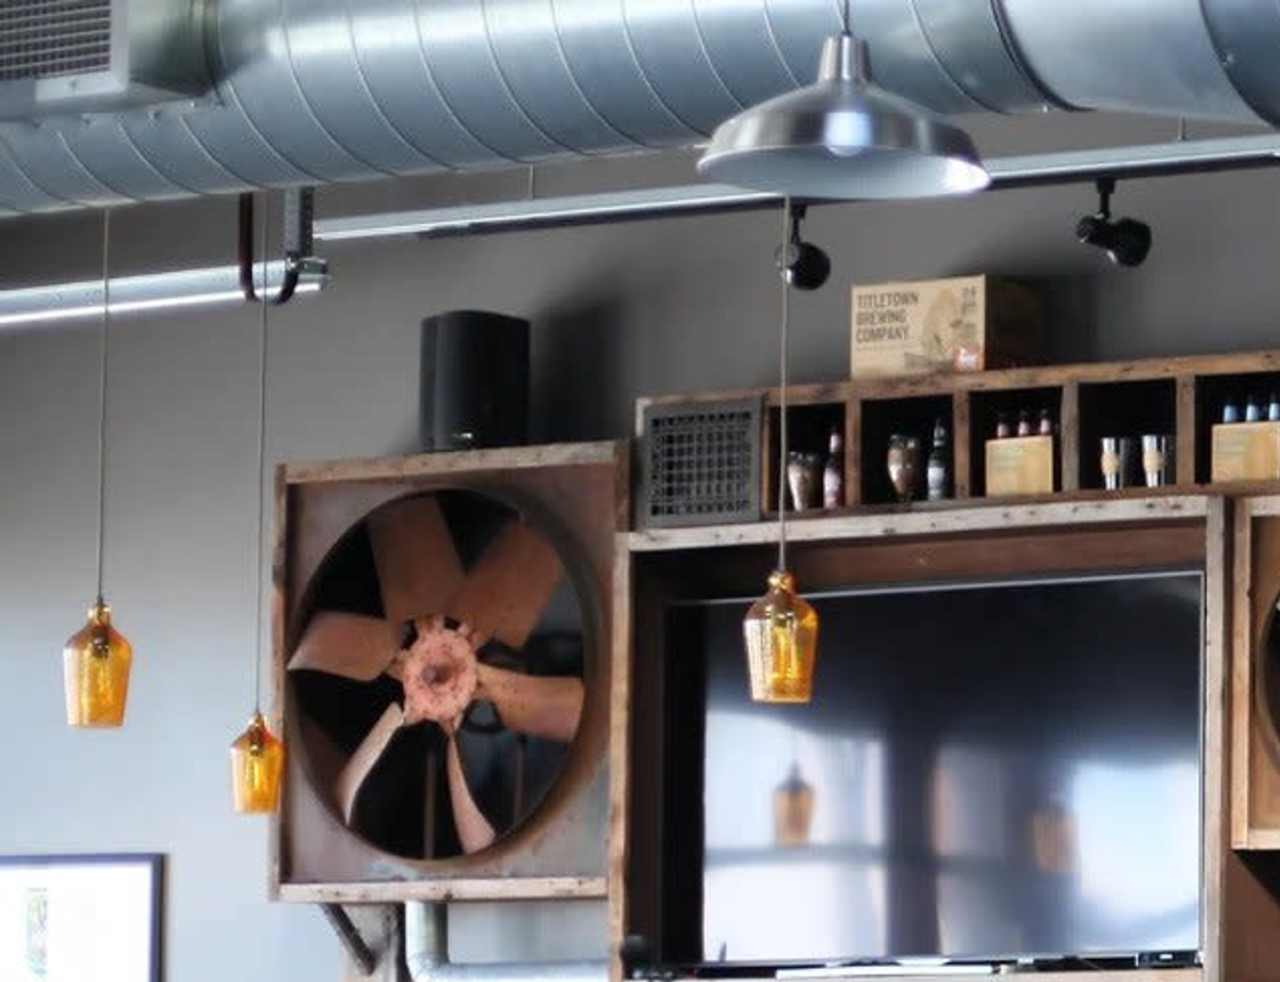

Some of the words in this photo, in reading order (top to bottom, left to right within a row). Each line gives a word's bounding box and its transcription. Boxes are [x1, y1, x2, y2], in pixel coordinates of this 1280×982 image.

[856, 291, 919, 308] TITLETOWN
[856, 308, 907, 326] BREWING
[856, 324, 909, 343] COMPANY
